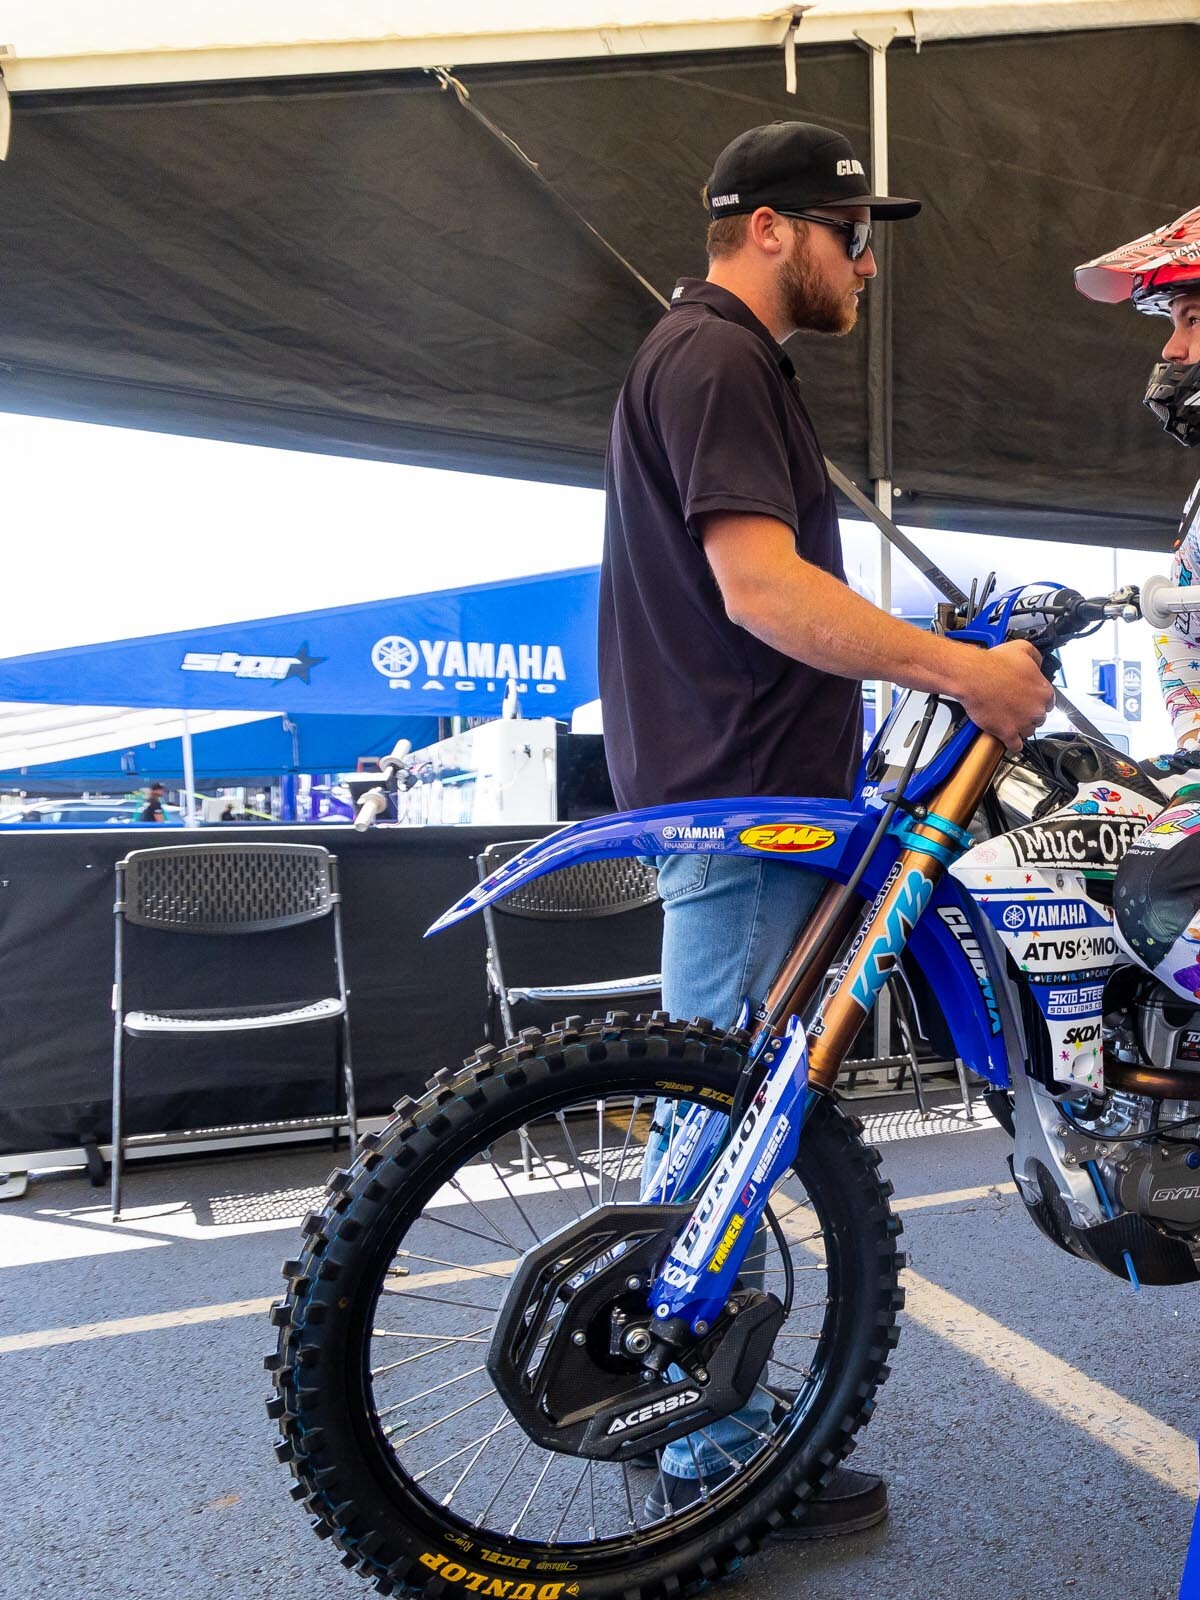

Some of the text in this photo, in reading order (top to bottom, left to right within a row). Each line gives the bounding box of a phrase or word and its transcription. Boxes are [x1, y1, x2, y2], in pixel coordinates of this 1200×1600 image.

[836, 159, 865, 176] CLU
[419, 640, 567, 681] YAMAHA
[677, 828, 725, 839] YAMAHA
[741, 828, 834, 845] FMF
[1019, 824, 1146, 861] Muc-Off
[1027, 904, 1087, 927] YAMAHA
[1022, 935, 1126, 961] ATVS&MO
[1049, 984, 1104, 1005] SKID STEE
[1049, 1002, 1103, 1014] SOLUTIONS.CO
[699, 1088, 734, 1105] EXCE
[681, 1081, 770, 1258] DUNLOP
[709, 1213, 744, 1273] TAMER
[660, 1262, 698, 1293] KDA
[607, 1391, 700, 1435] ACERBIS
[481, 1549, 531, 1570] EXCEL
[419, 1552, 566, 1600] DUNLOP
